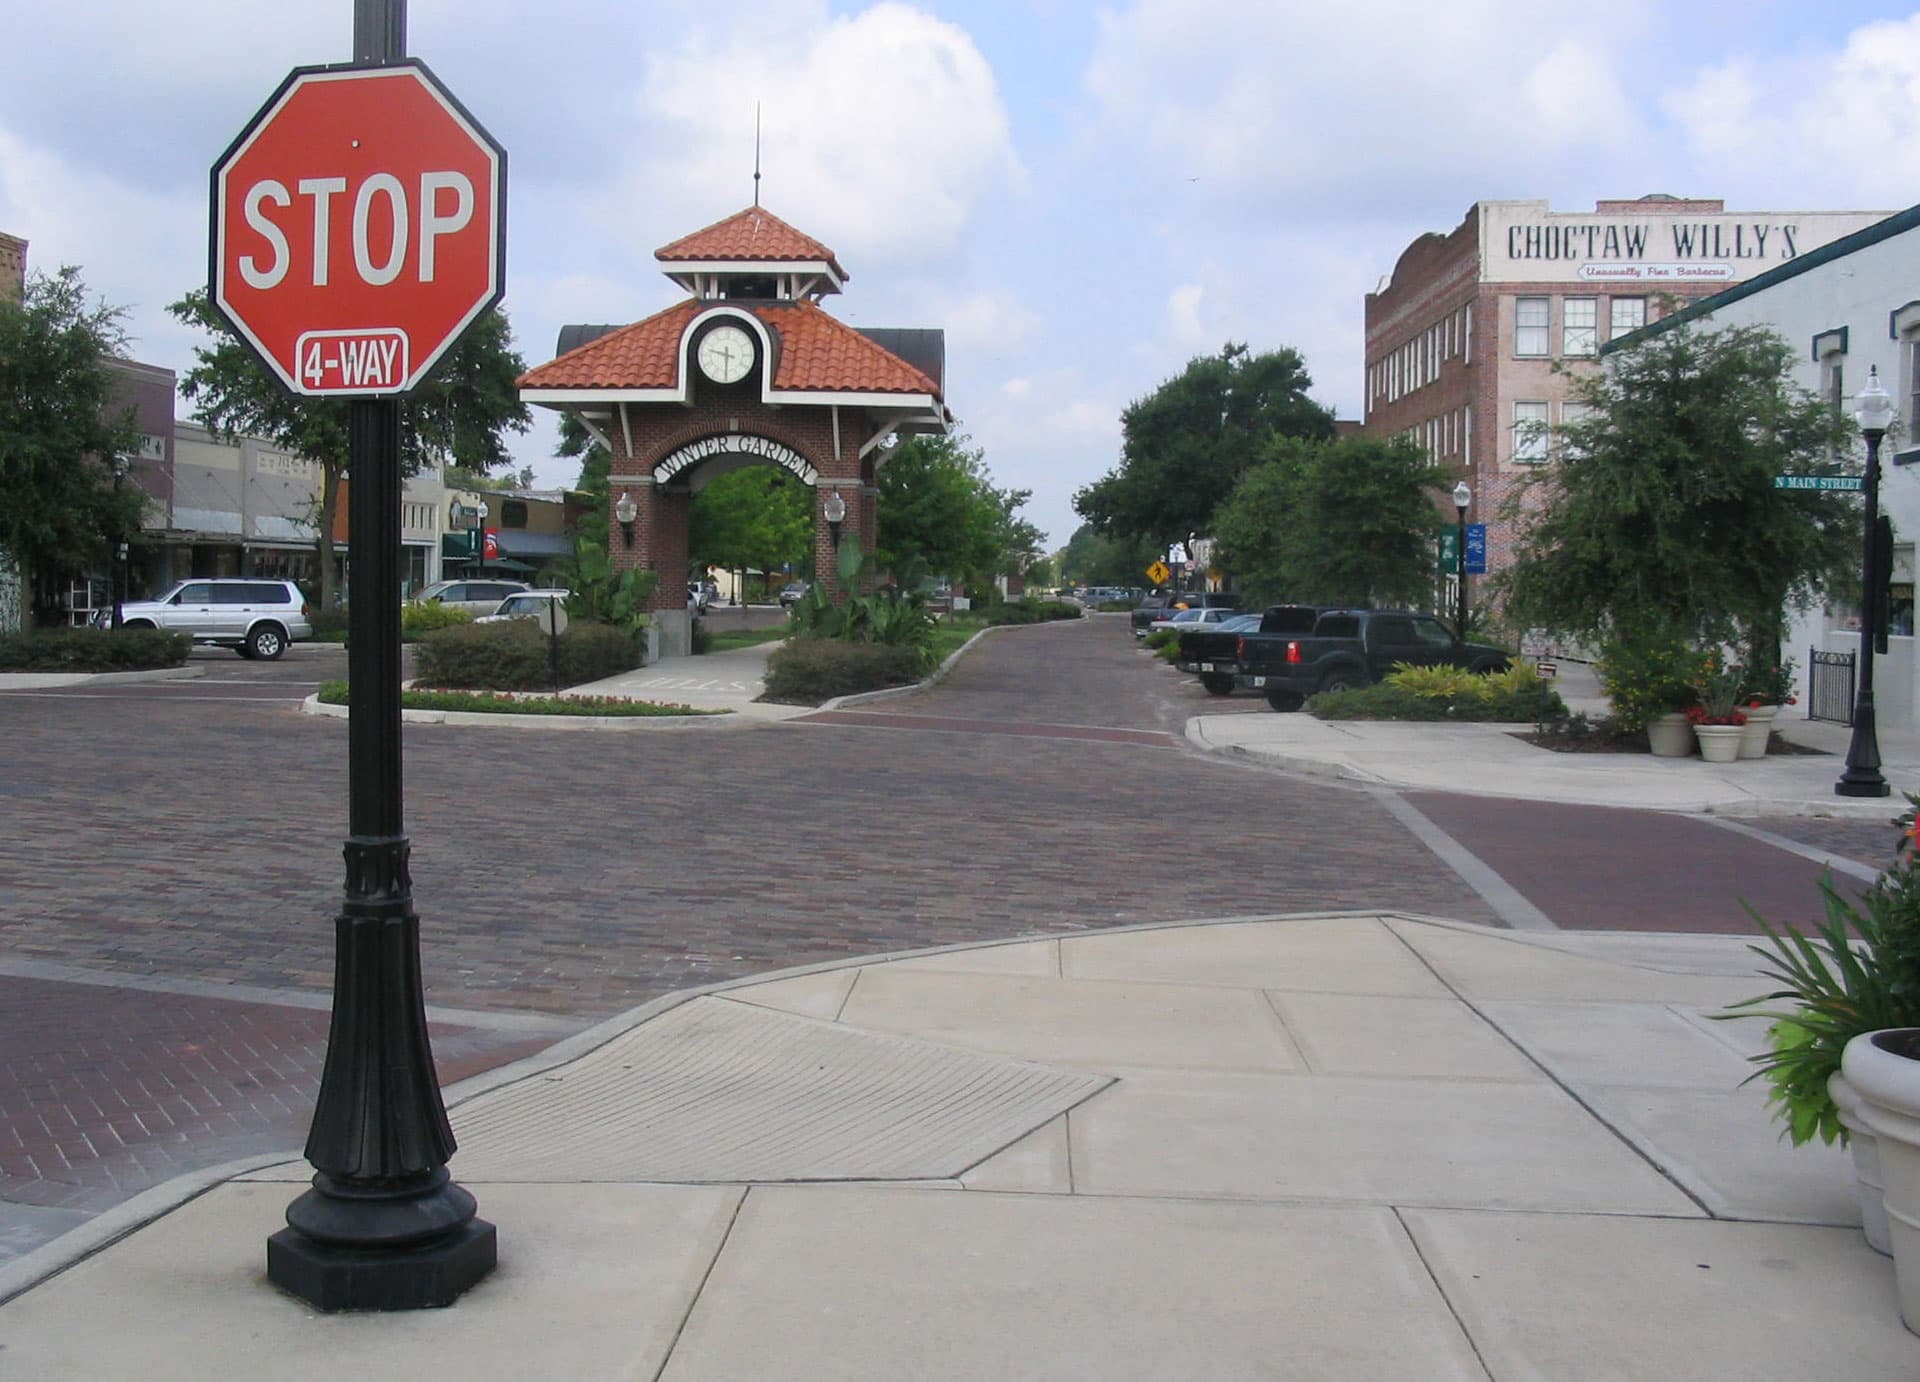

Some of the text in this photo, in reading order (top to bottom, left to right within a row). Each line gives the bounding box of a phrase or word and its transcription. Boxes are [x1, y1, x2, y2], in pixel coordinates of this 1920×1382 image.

[239, 171, 475, 290] STOP
[1508, 223, 1797, 260] CHOCTAW WILLY'S
[1586, 266, 1726, 278] Unusually Fine Barbecue
[305, 339, 398, 387] 4-WAY
[659, 436, 813, 479] WINTER GARDEN
[1775, 477, 1862, 489] N MAIN STREET
